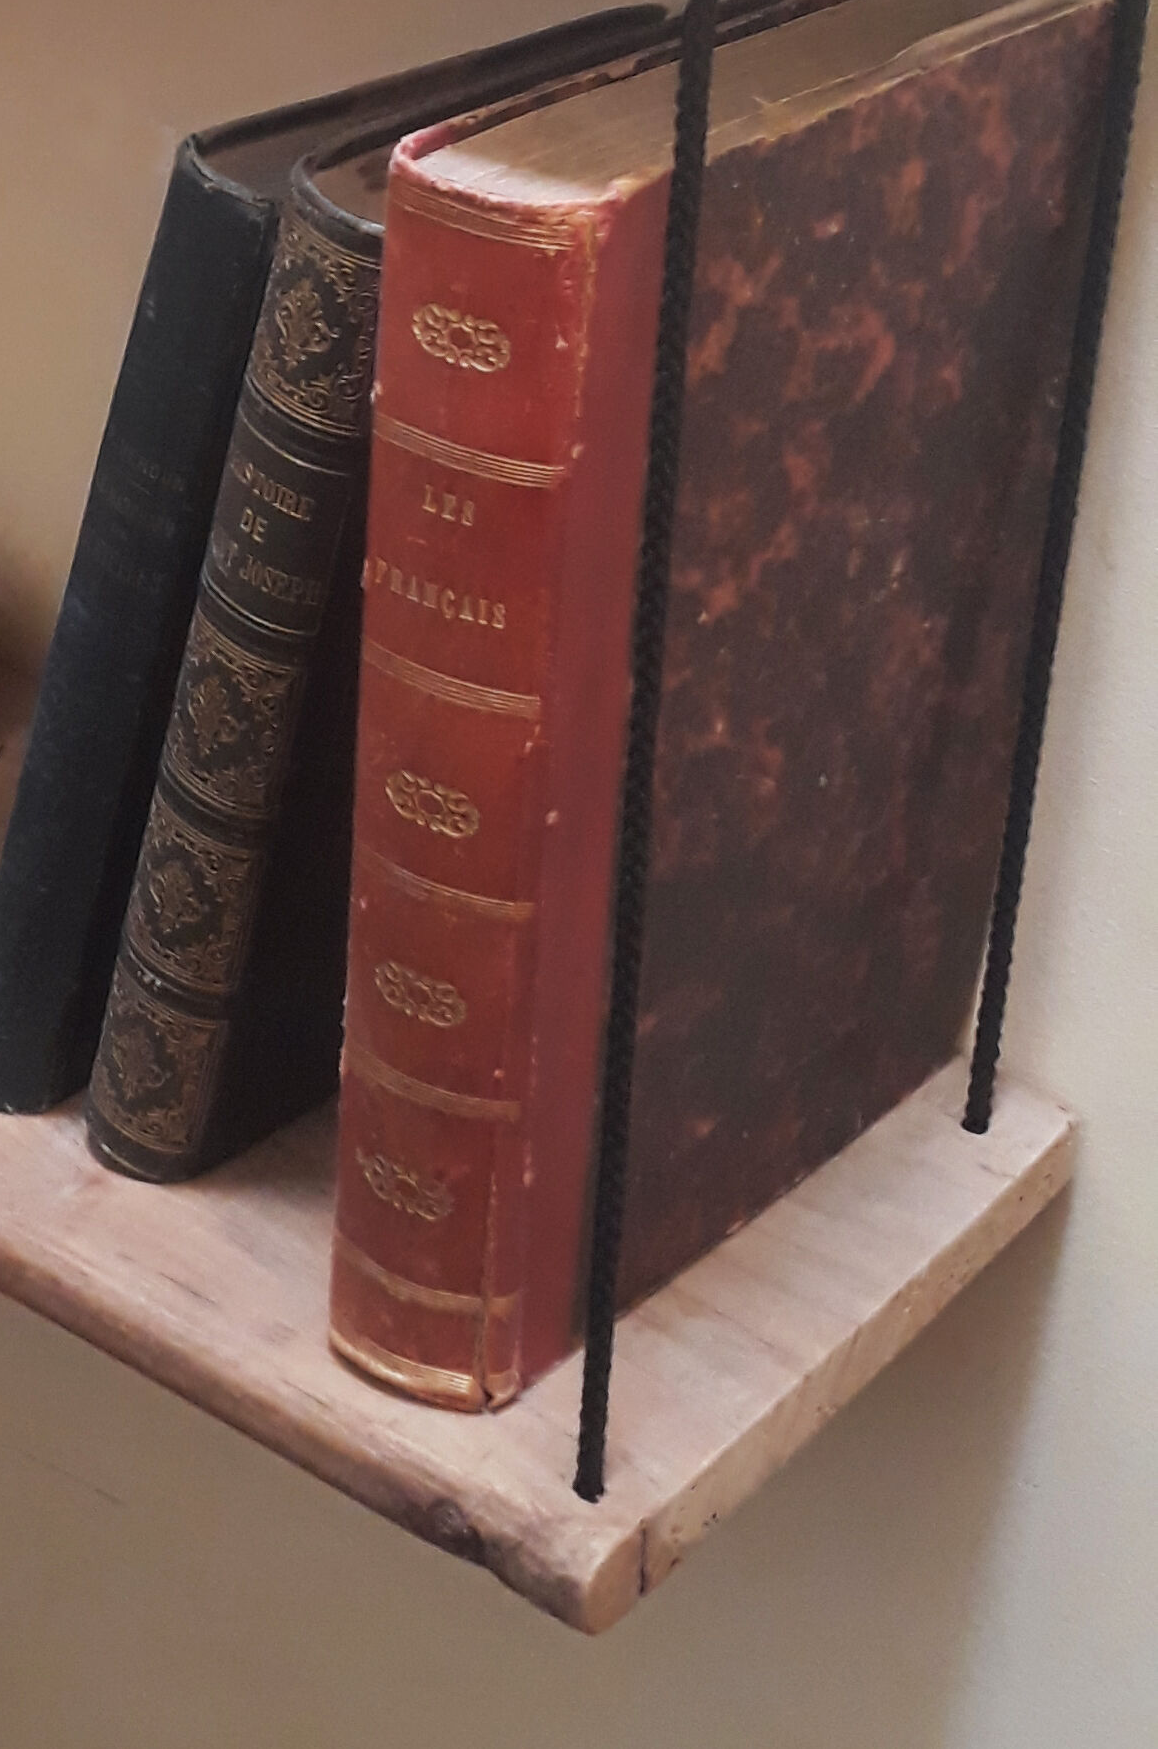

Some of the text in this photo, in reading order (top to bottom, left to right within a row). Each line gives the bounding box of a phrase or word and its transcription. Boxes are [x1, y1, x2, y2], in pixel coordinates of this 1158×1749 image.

[239, 505, 269, 543] DE
[421, 483, 475, 527] LES
[373, 555, 507, 631] FRANÇAIS
